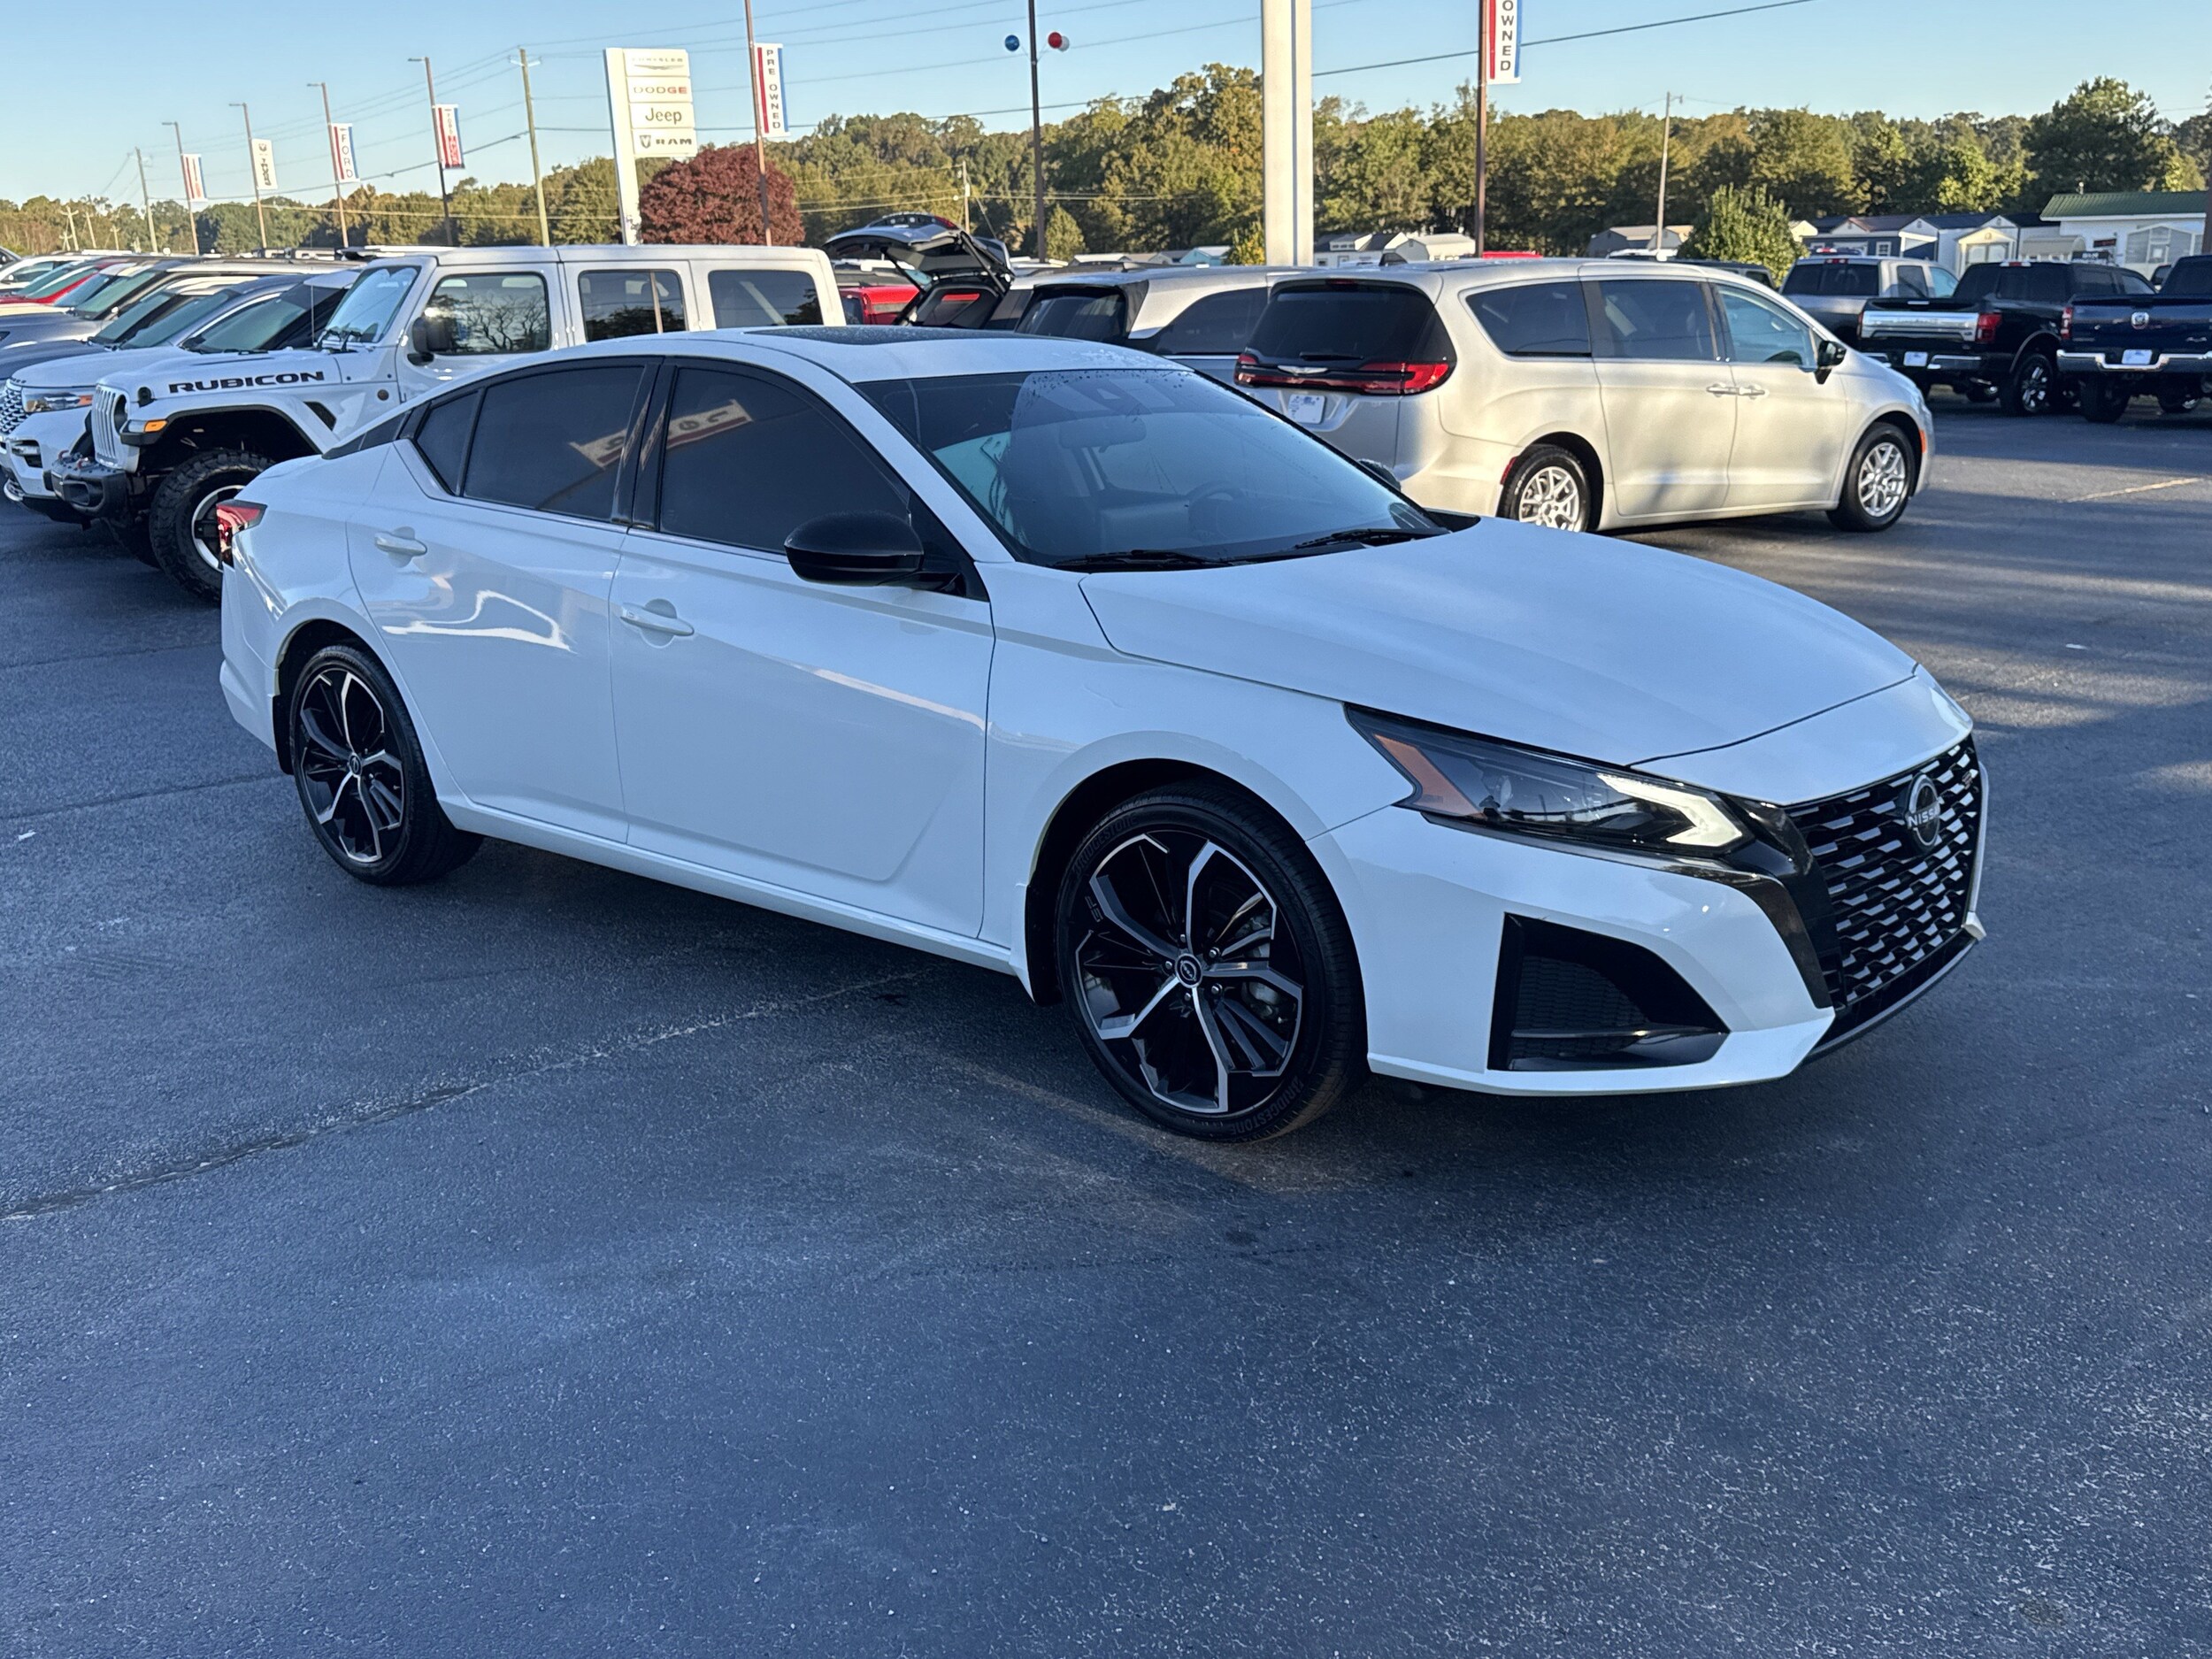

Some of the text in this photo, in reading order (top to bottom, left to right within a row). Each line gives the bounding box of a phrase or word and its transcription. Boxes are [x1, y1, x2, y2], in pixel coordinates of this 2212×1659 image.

[1501, 0, 1514, 72] OWNED
[633, 86, 687, 95] DODGE
[766, 49, 781, 129] PRE OWNED
[644, 107, 682, 126] Jeep
[341, 134, 354, 179] FORD
[168, 371, 325, 394] RUBICON
